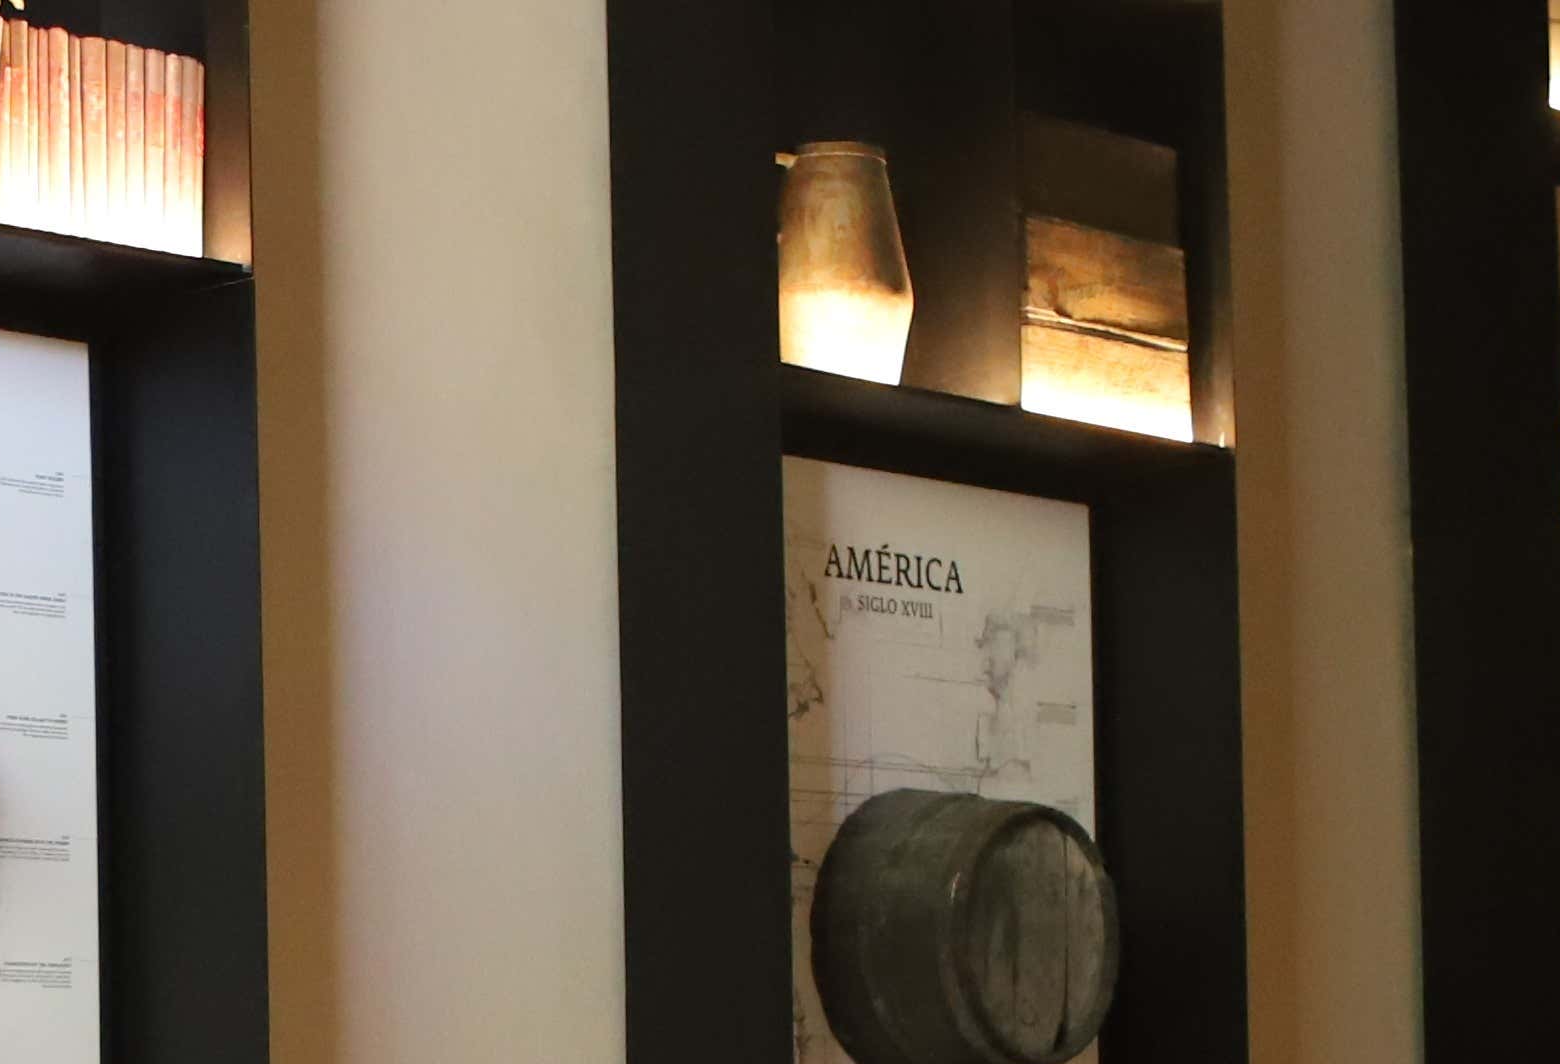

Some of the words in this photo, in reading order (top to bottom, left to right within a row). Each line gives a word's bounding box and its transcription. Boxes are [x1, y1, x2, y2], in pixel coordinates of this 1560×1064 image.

[824, 543, 964, 594] AMÉRICA
[857, 594, 897, 614] SIGLO
[901, 600, 933, 618] XVIII
